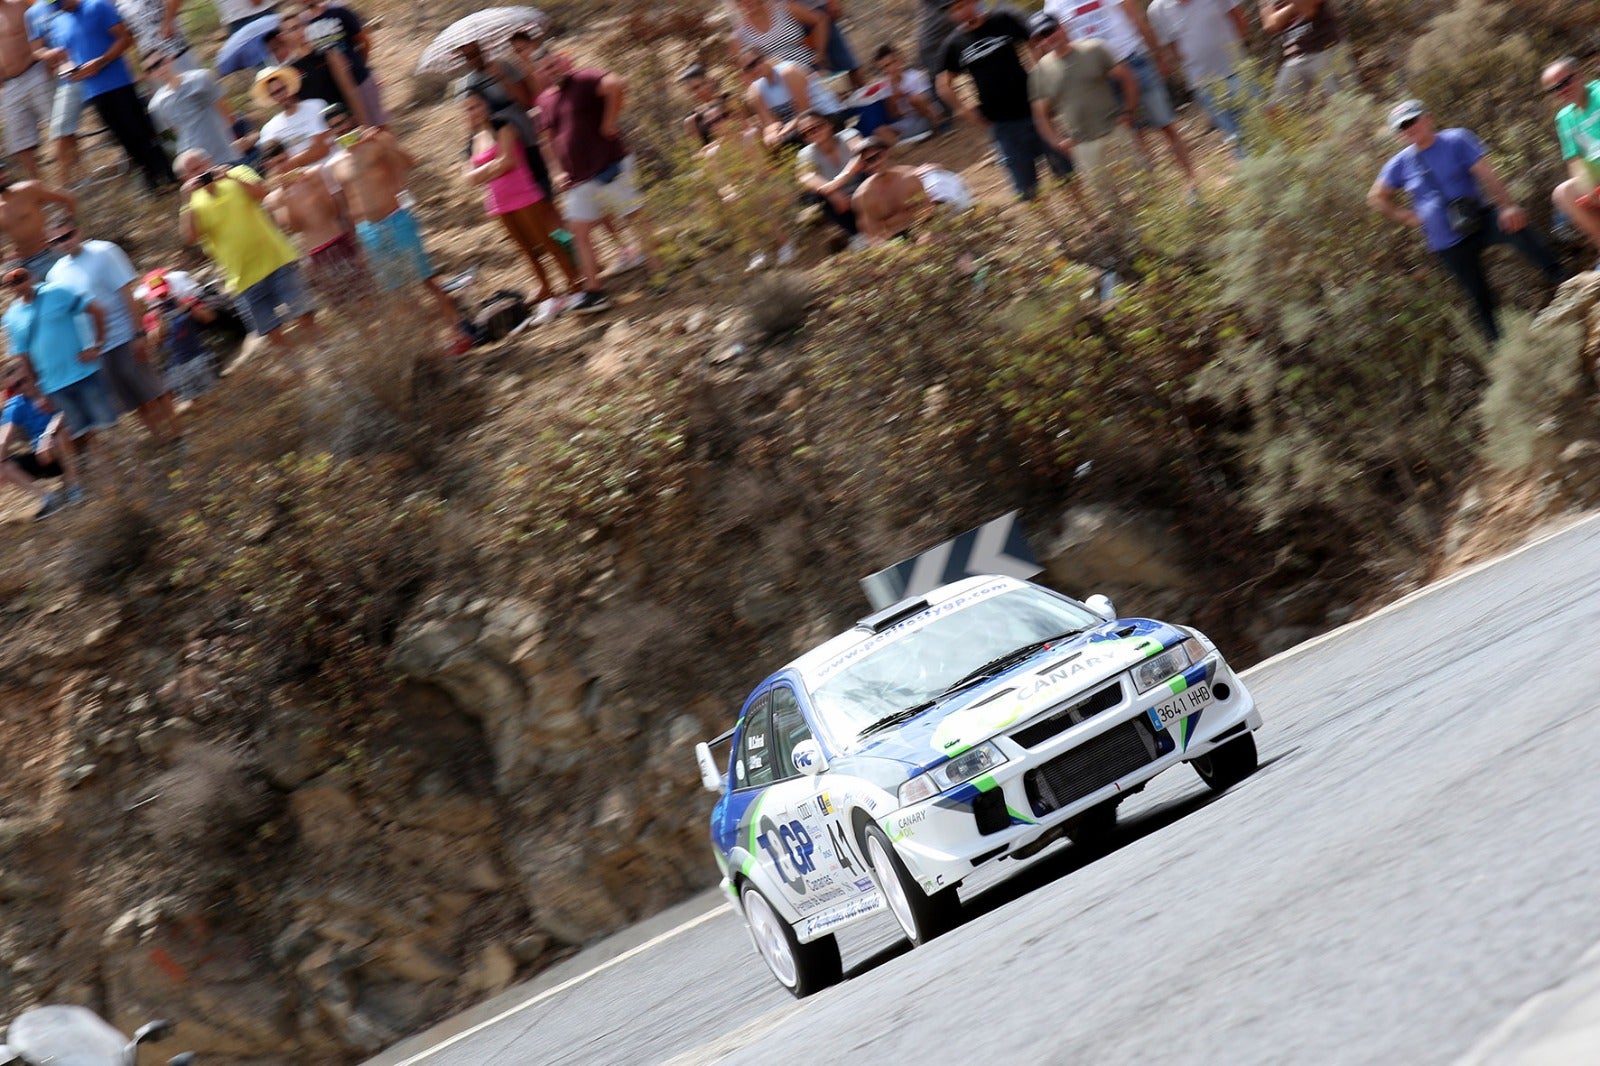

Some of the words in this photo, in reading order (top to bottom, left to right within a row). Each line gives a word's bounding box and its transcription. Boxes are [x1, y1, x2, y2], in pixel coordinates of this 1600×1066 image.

[1017, 649, 1115, 701] CANARY
[1157, 698, 1187, 722] 3641
[898, 810, 927, 829] CANARY
[826, 819, 867, 877] 41
